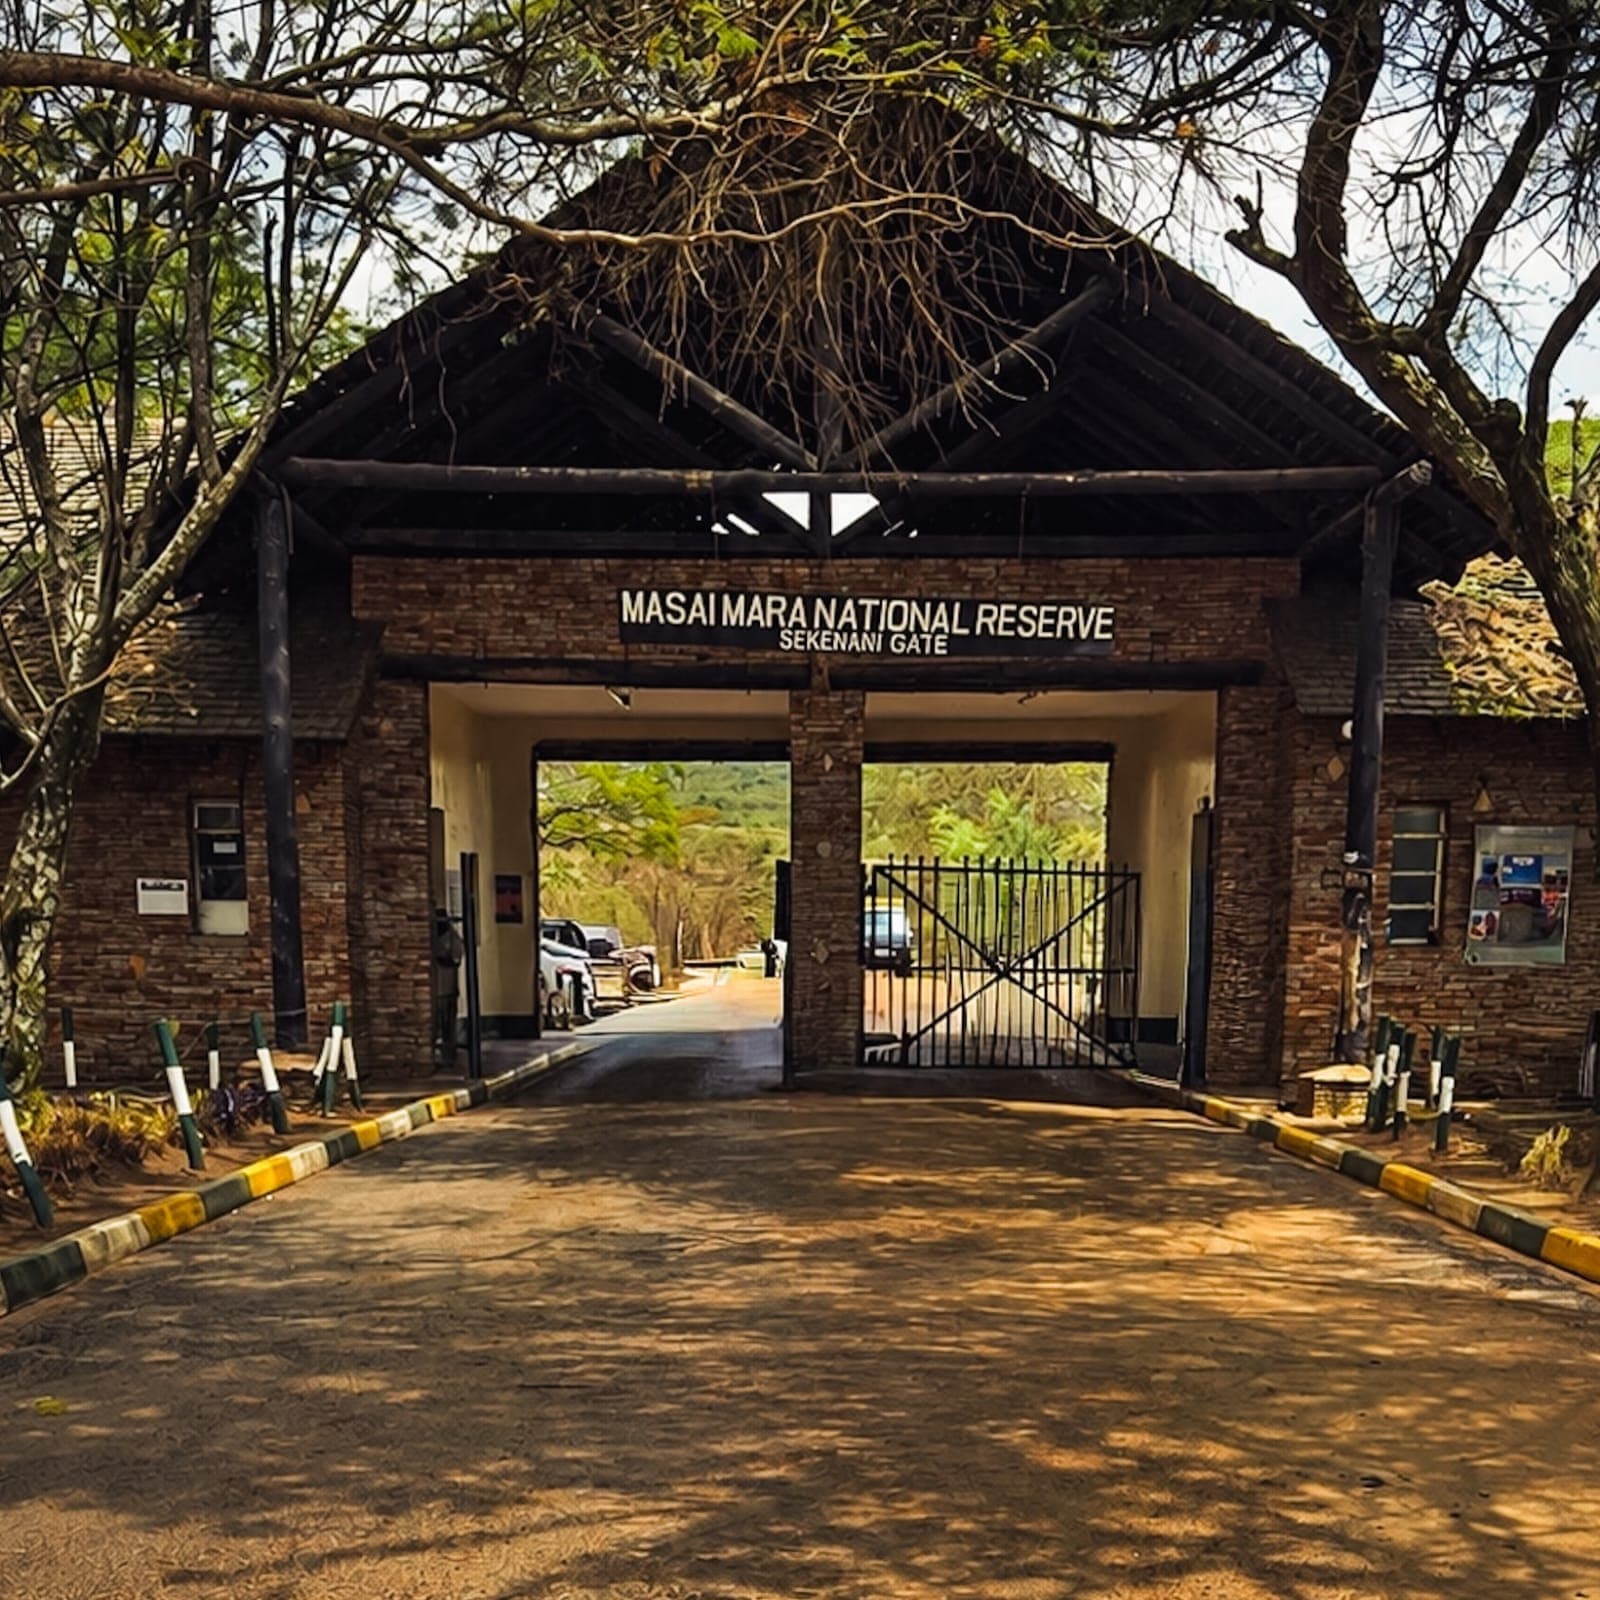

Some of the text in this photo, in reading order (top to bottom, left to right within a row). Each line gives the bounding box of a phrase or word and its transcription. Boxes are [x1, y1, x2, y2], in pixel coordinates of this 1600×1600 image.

[621, 590, 1114, 640] MASAI MARA NATIONAL RESERVE
[779, 628, 948, 655] SEKENANI GATE
